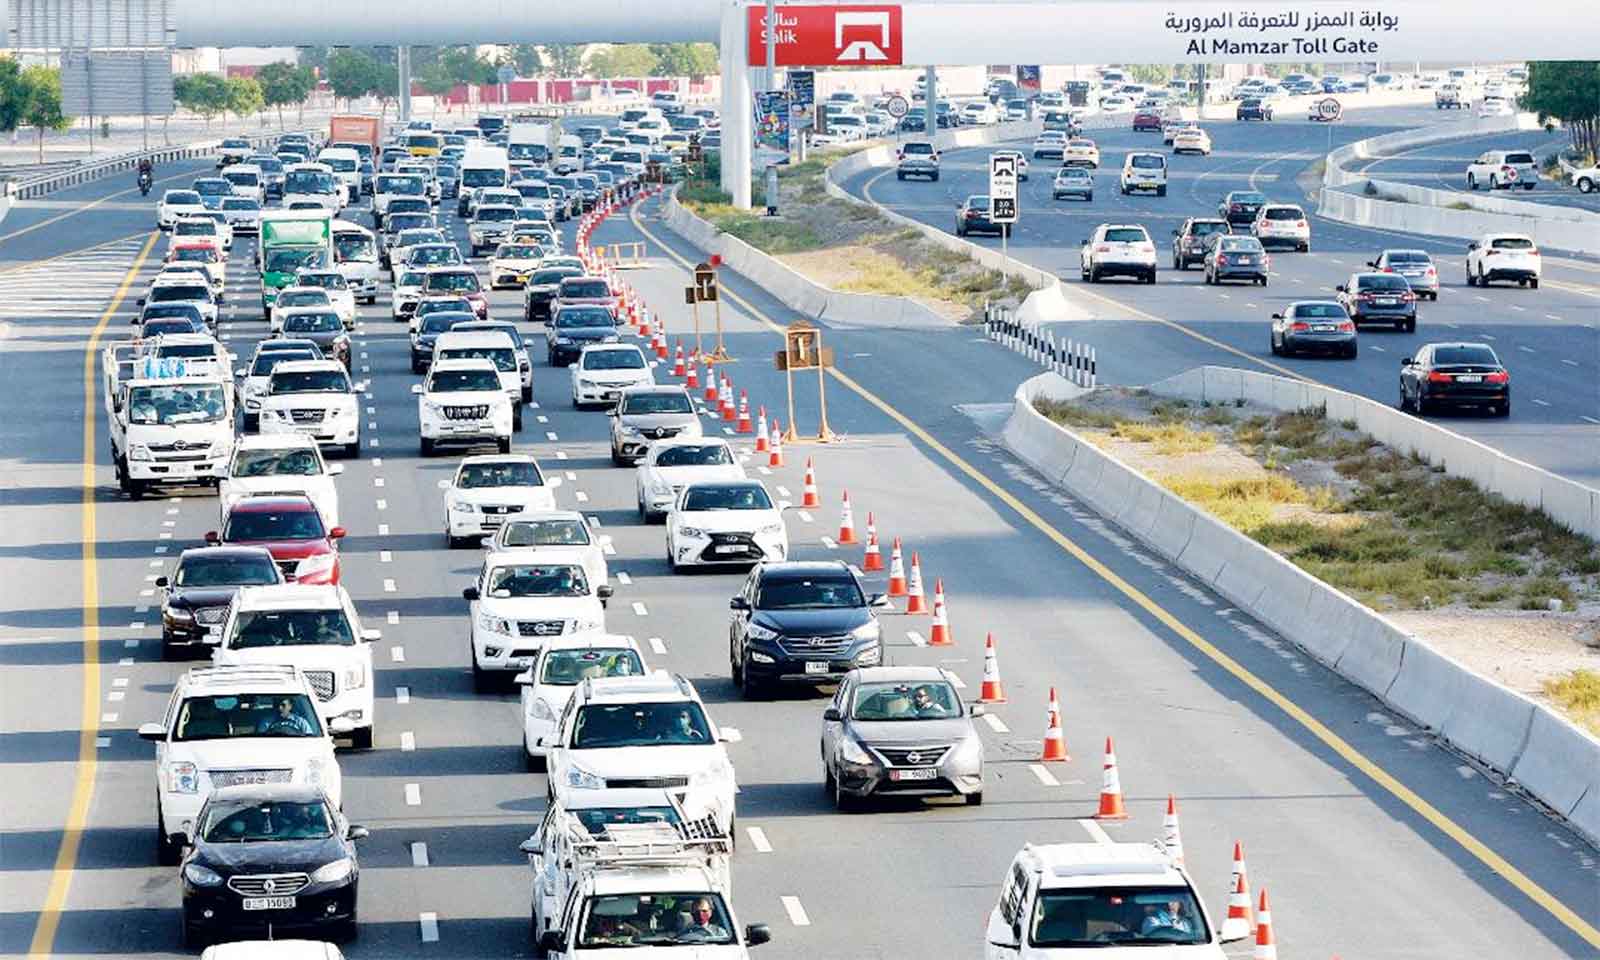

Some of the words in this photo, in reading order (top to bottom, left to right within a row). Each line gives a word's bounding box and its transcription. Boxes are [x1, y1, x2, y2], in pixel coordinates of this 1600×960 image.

[1165, 11, 1233, 33] المرورية
[1238, 11, 1300, 32] للتعرفة
[1304, 11, 1354, 32] الممزر
[1358, 11, 1399, 32] بوابة
[1186, 38, 1207, 54] Al
[1212, 38, 1289, 54] Mamzar
[1291, 37, 1328, 54] Toll
[1332, 37, 1379, 54] Gate
